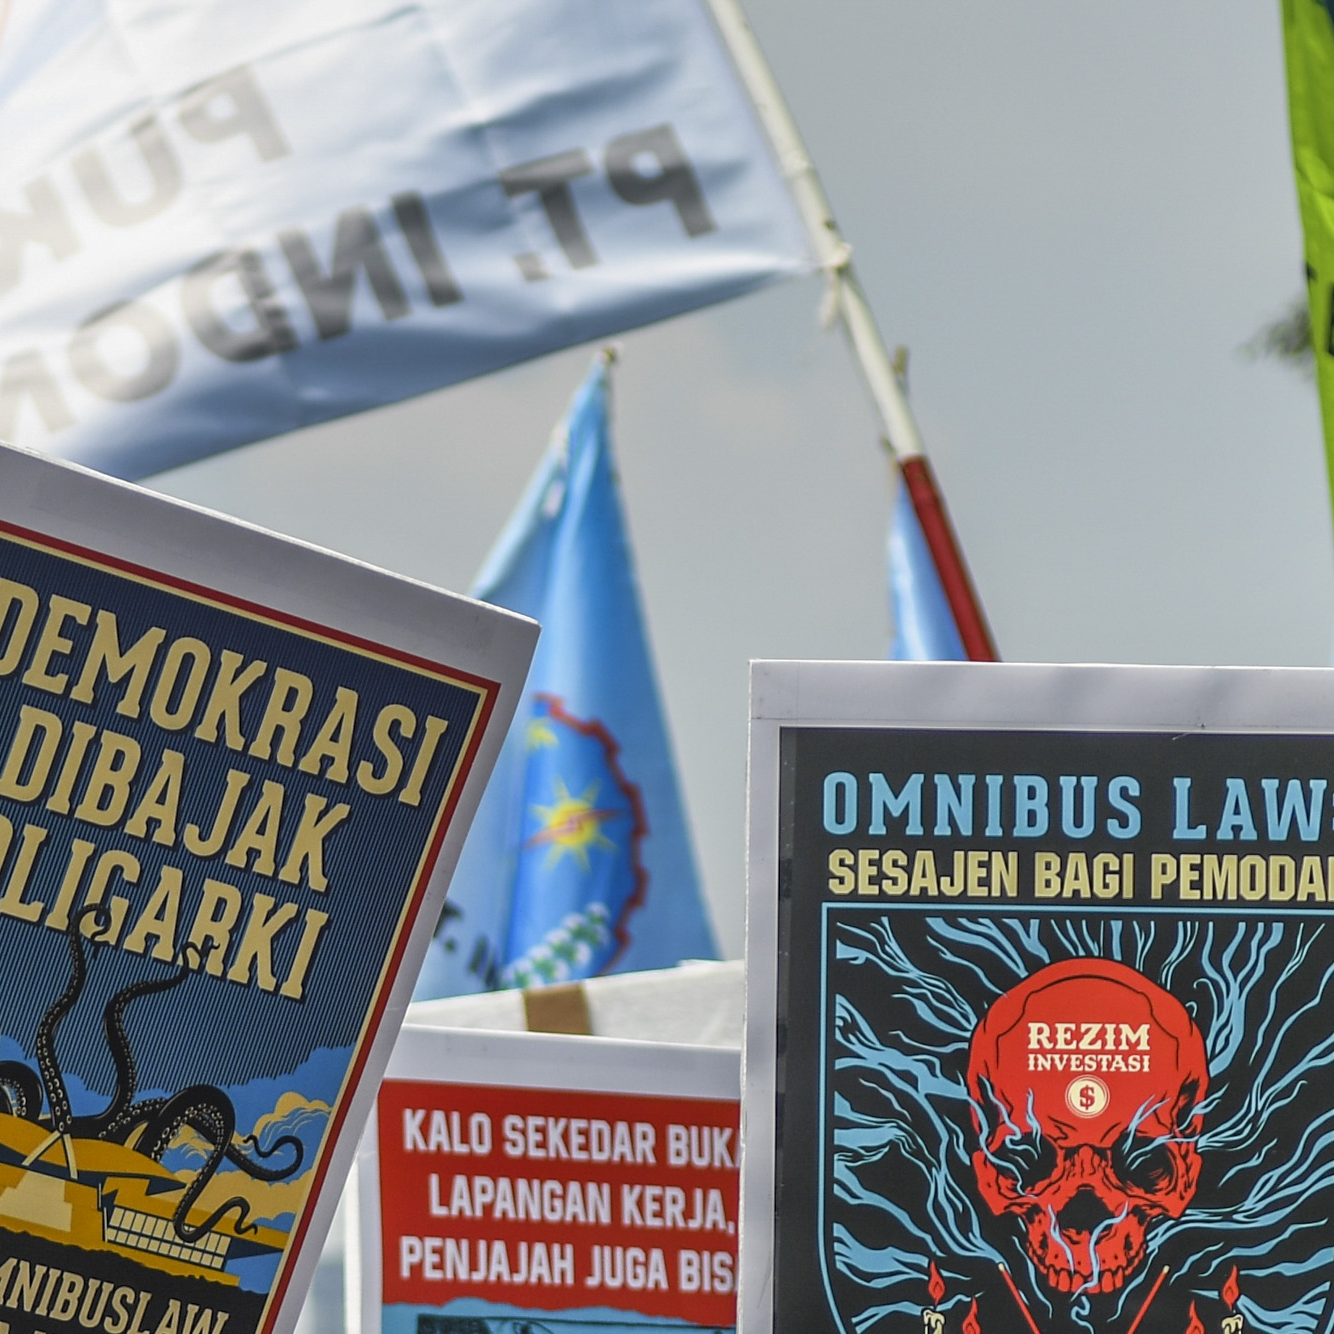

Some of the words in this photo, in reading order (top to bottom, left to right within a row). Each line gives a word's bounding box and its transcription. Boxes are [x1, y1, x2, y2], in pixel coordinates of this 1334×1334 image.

[823, 771, 1142, 839] OMNIBUS
[828, 849, 1019, 898] SESAJEN
[1034, 851, 1134, 899] BAGI
[1027, 1022, 1151, 1051] REZIM
[1027, 1054, 1150, 1072] INVESTASI
[402, 1108, 492, 1155] KALO
[504, 1114, 656, 1164] SEKEDAR
[667, 1124, 740, 1168] BUK
[429, 1173, 611, 1224] LAPANGAN
[400, 1236, 574, 1285] PENJAJAH
[586, 1244, 669, 1290] JUGA
[679, 1250, 739, 1293] BIS
